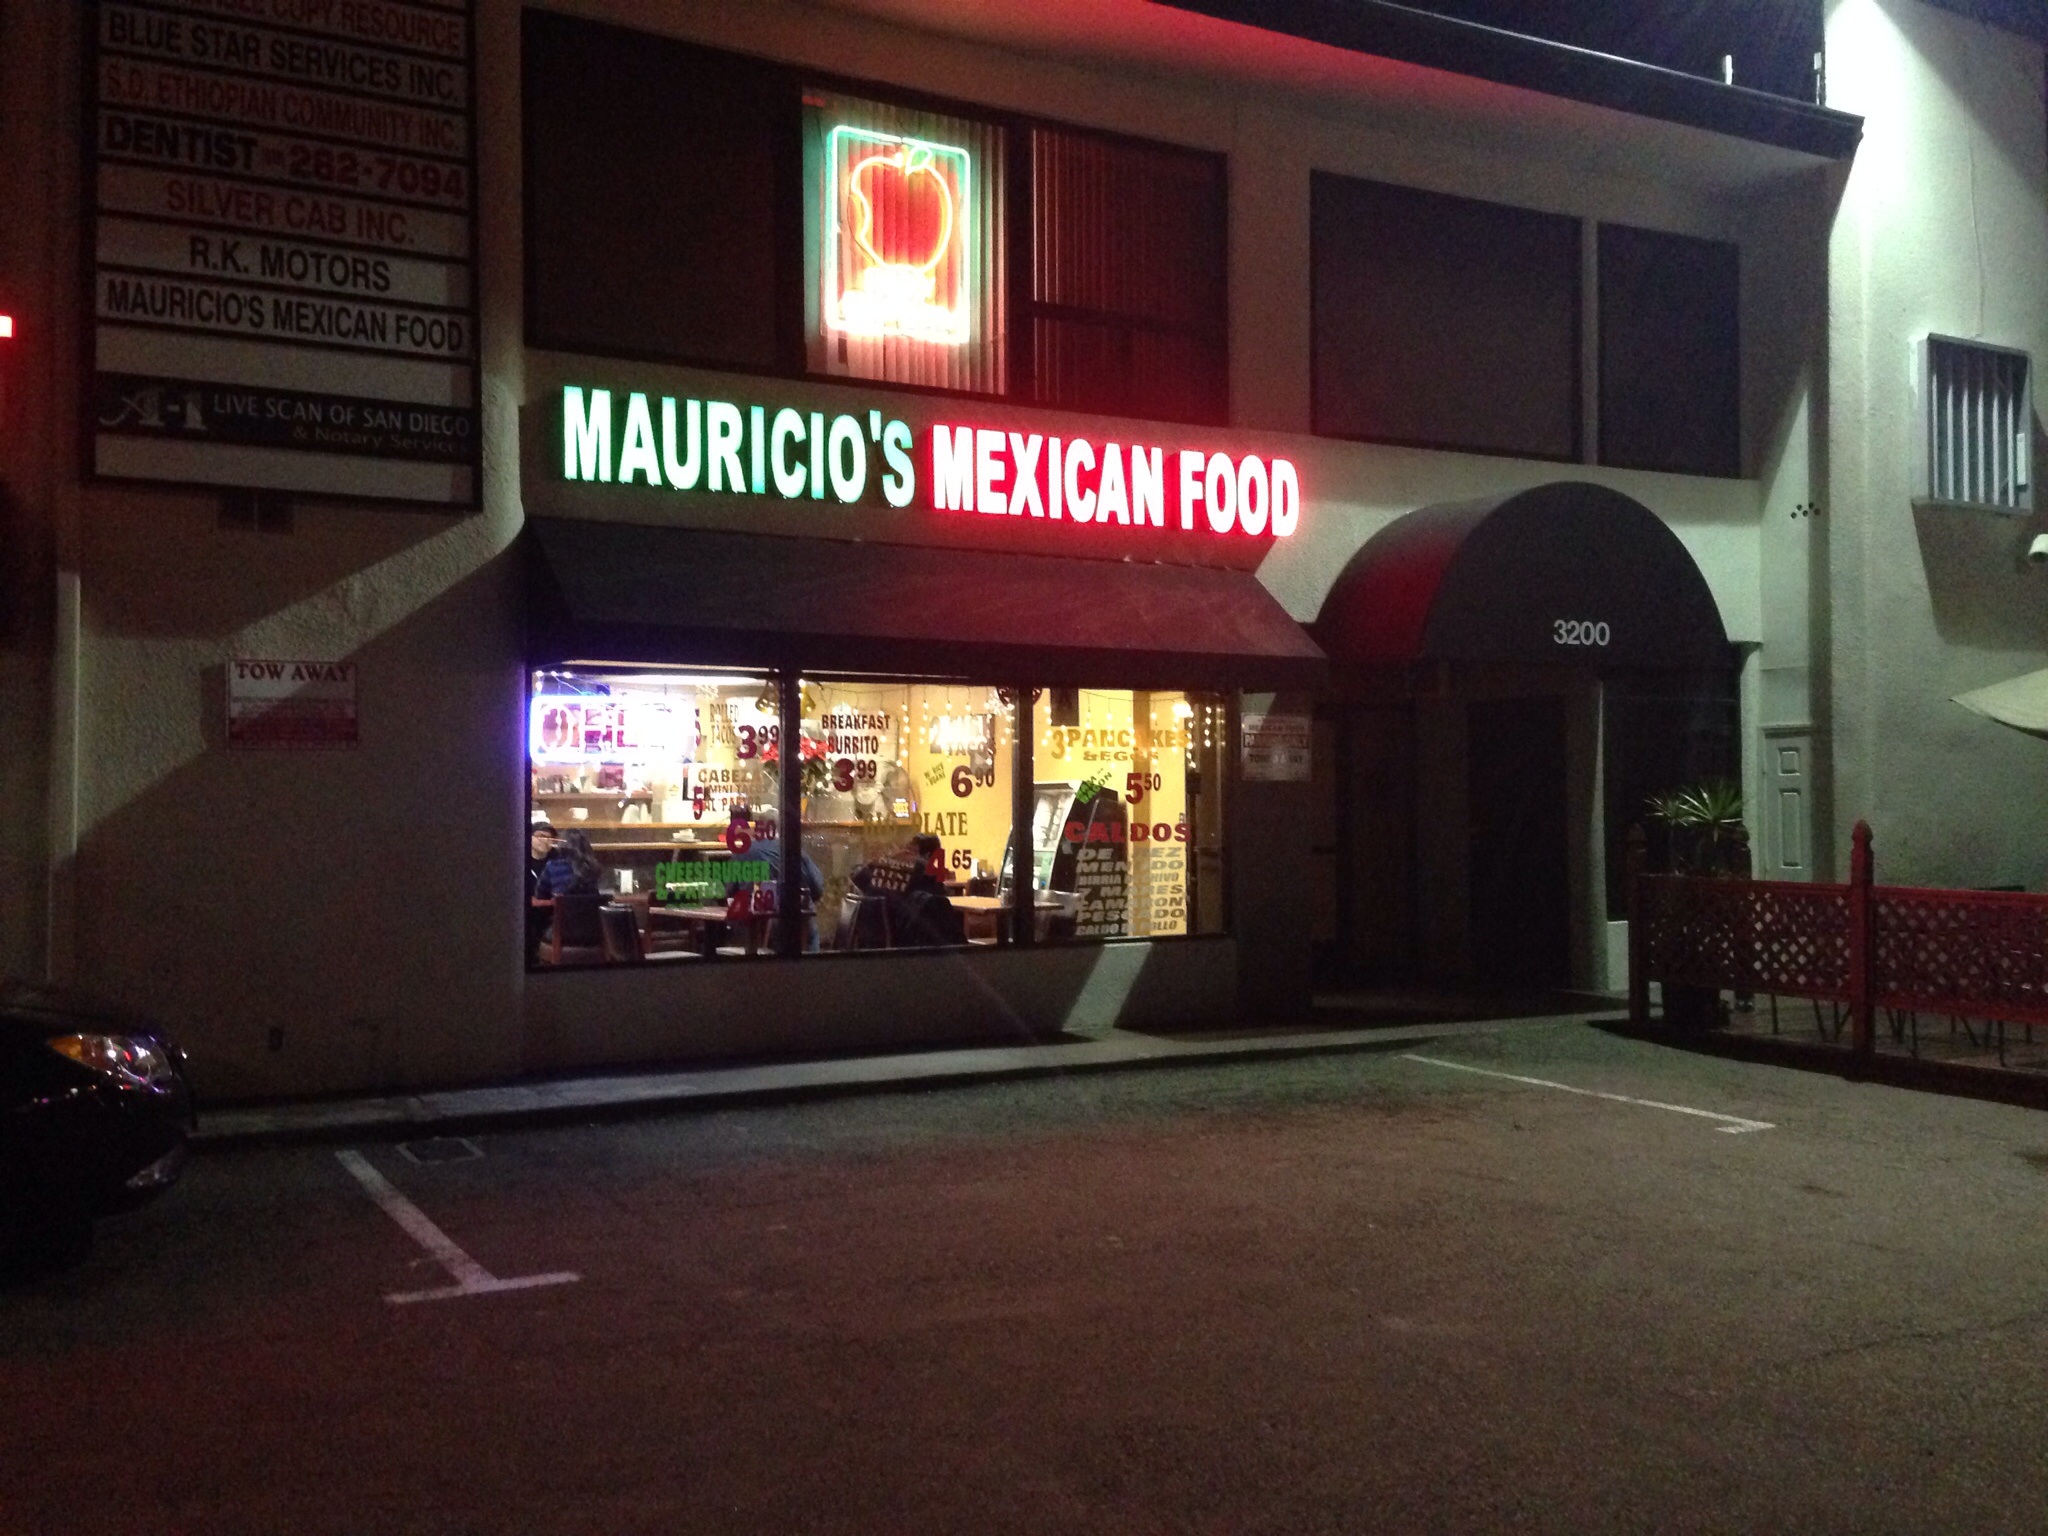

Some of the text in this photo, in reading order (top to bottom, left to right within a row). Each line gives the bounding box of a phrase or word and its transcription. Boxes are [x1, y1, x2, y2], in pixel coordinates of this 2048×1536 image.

[340, 4, 461, 51] RESOURCE
[108, 10, 182, 52] BLUE
[191, 25, 261, 67] STAR
[269, 41, 401, 91] SERVICES
[158, 71, 278, 119] ETHIOPIAN
[282, 95, 414, 141] COMMUNITY
[104, 115, 258, 171] DENTIST
[167, 179, 415, 245] SILVER CAB INC.
[189, 236, 392, 293] R.K. MOTORS
[107, 279, 464, 351] MAURICIO'S MEXICAN FOOD
[213, 393, 258, 416] LIVE
[265, 398, 323, 423] SCAN
[330, 404, 357, 426] OF
[363, 408, 403, 430] SAN
[409, 414, 471, 437] DIEGO
[563, 385, 1301, 537] MAURICIO'S MEXICAN FOOD
[1553, 619, 1610, 646] 3200
[236, 663, 350, 681] TOW AWAY
[821, 714, 891, 731] BREAKFAST
[828, 735, 879, 756] BURRITO
[1064, 823, 1191, 843] CALDOS
[655, 861, 771, 883] CHEESEBURGER
[1076, 860, 1184, 874] MENDO
